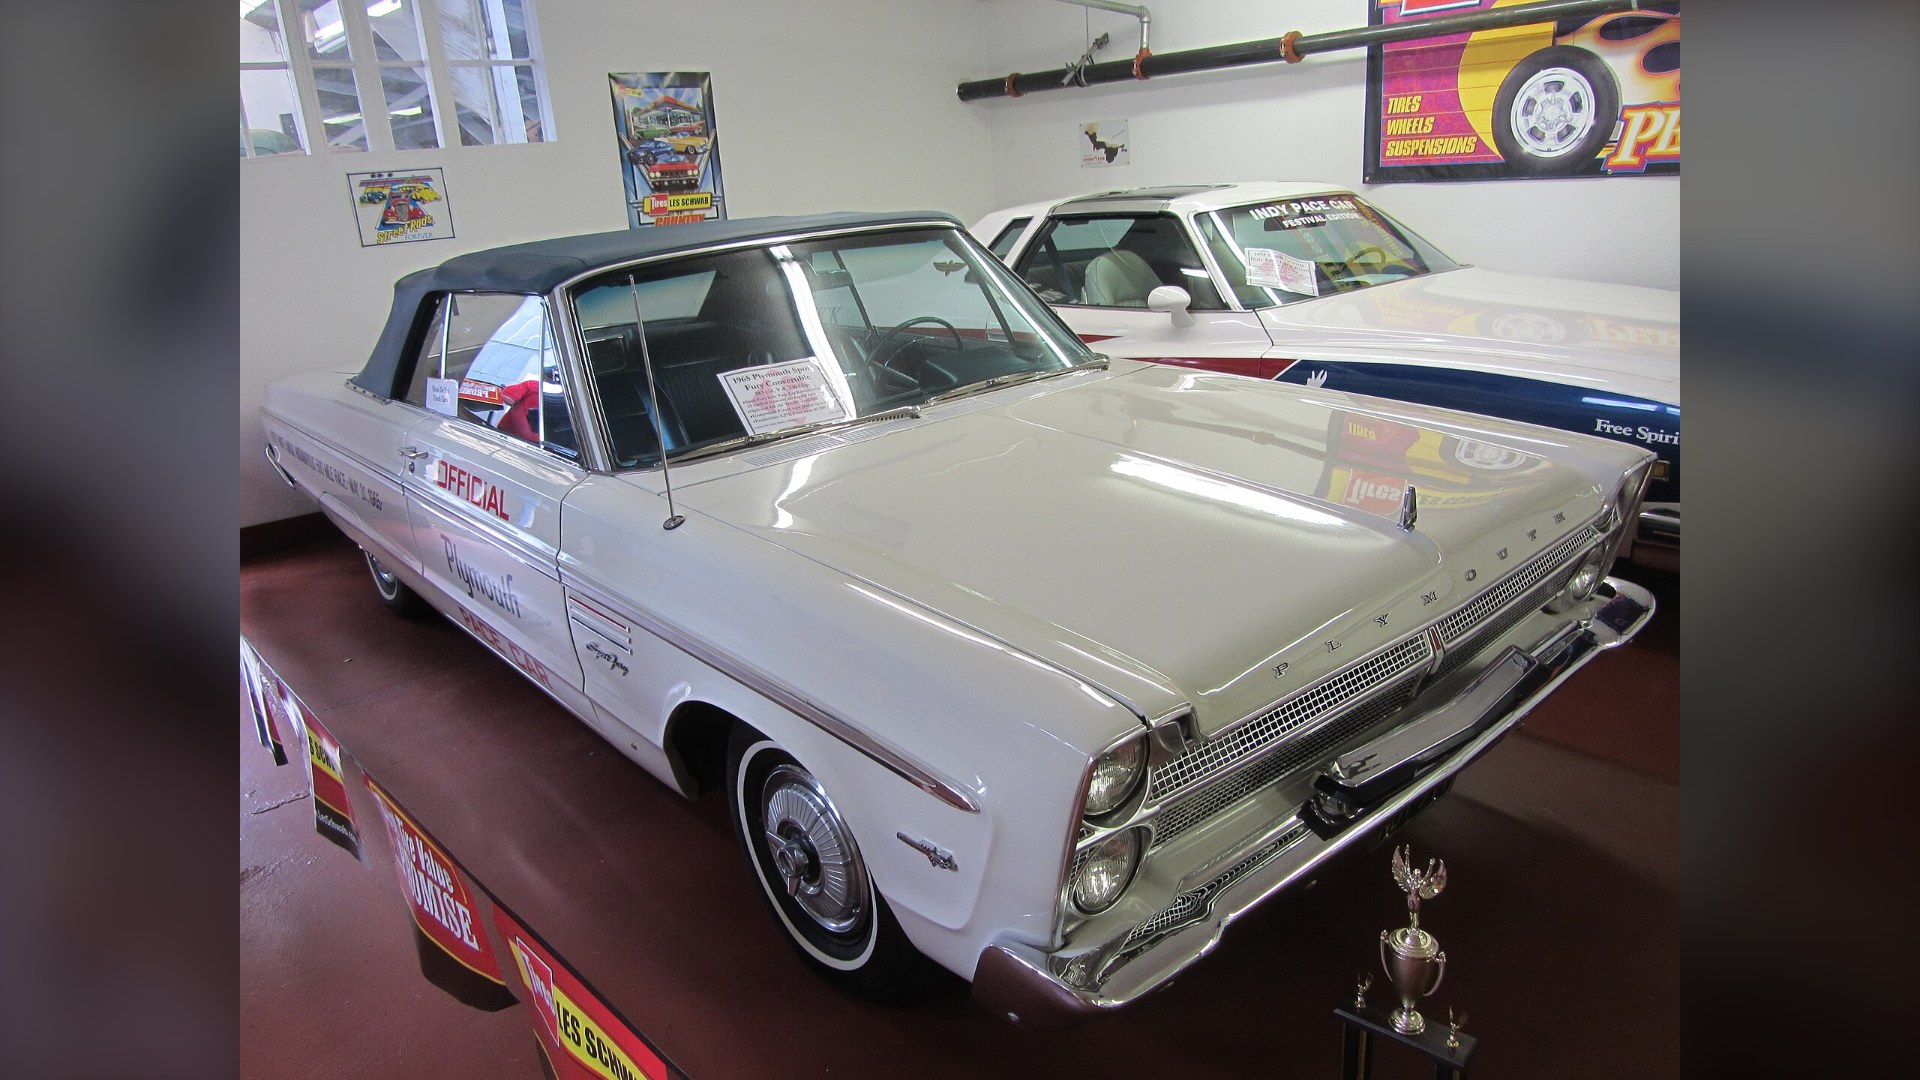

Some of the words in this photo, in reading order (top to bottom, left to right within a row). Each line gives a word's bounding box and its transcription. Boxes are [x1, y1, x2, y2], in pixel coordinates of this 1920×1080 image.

[1387, 96, 1421, 114] TIRES
[1386, 117, 1435, 136] WHEELS
[1386, 137, 1477, 157] SUSPENSIONS
[650, 197, 668, 210] Tires
[669, 199, 680, 208] LES
[681, 197, 709, 207] SCHWAB
[1249, 204, 1292, 220] INDY
[1293, 200, 1330, 213] PACE
[1329, 200, 1357, 211] CAR
[377, 222, 408, 244] Street
[410, 214, 434, 232] Rods
[1282, 215, 1327, 229] FESTIVAL
[1327, 213, 1361, 222] EDITION
[404, 232, 433, 241] FOREVER
[732, 376, 751, 385] 1965
[752, 369, 792, 381] Plymouth
[744, 382, 764, 392] Fury
[765, 375, 811, 388] Convertible
[1594, 418, 1632, 436] Free
[1636, 426, 1680, 445] Spiri
[436, 460, 510, 521] OFFICIAL
[440, 533, 521, 619] Plymouth
[1273, 512, 1566, 679] PLYMOUTH
[459, 606, 505, 654] PACE
[508, 642, 554, 689] CAR
[415, 834, 455, 895] Value
[556, 1000, 582, 1048] LES
